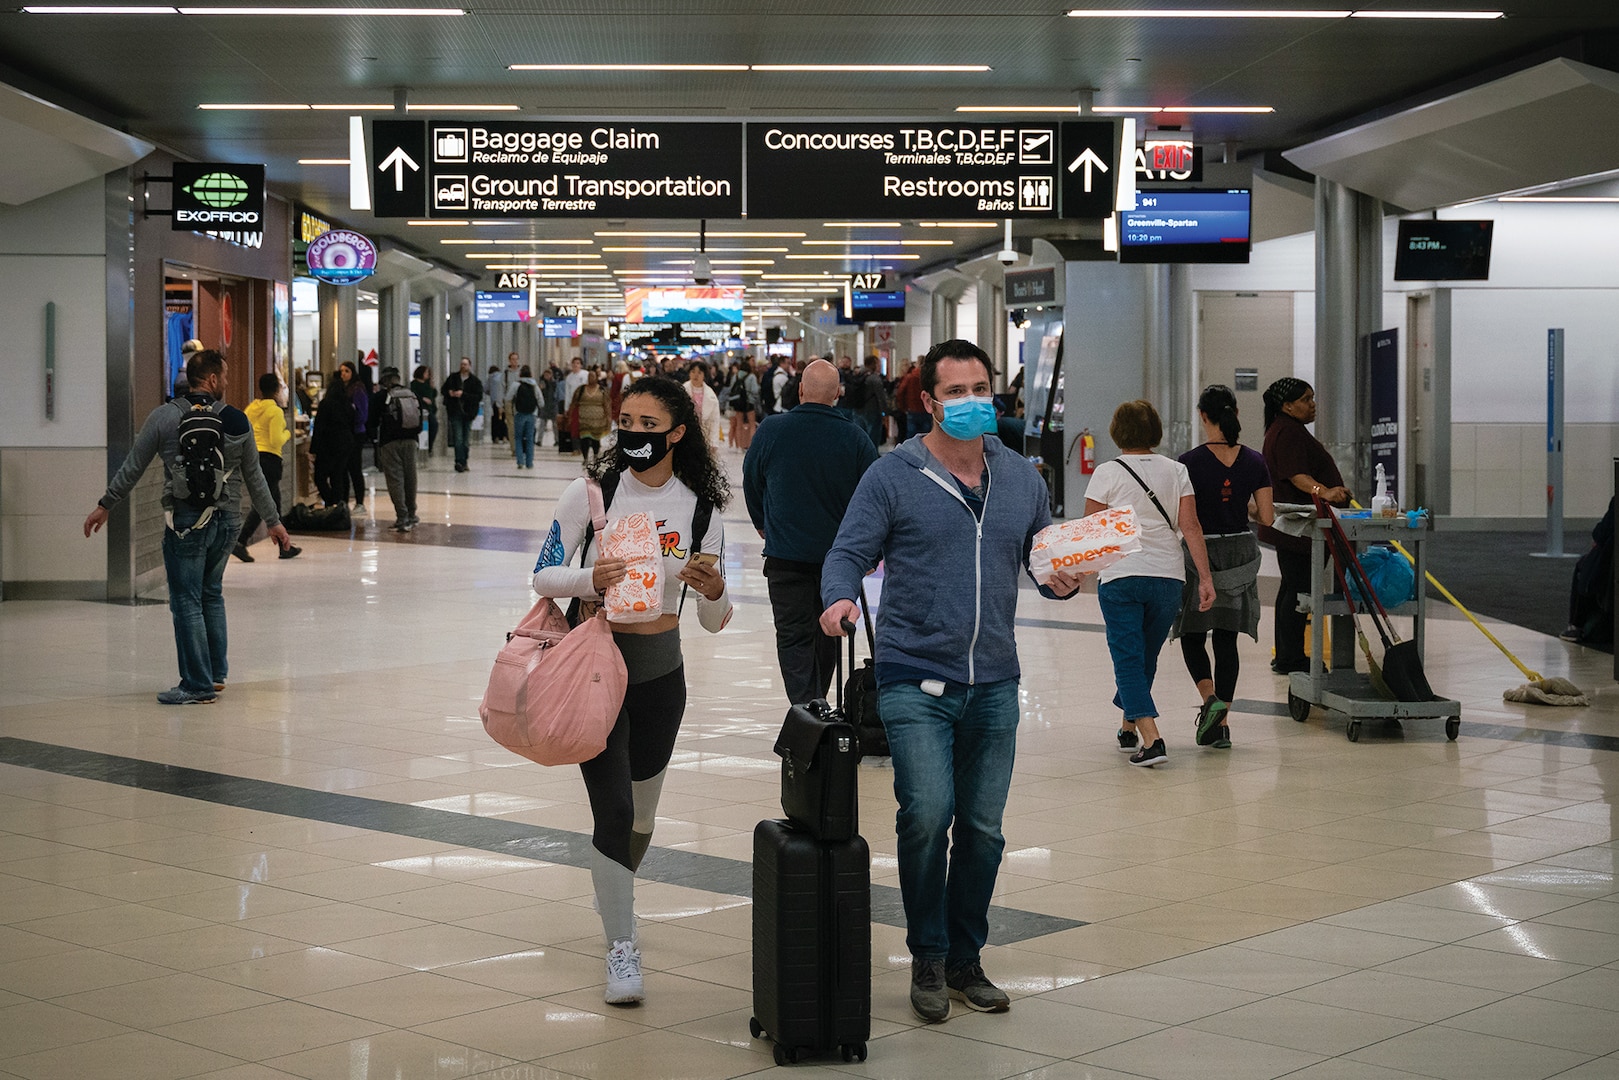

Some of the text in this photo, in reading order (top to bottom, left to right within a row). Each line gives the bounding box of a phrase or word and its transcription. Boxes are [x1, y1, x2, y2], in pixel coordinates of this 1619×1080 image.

[472, 128, 660, 152] Baggage Claim
[765, 129, 1015, 152] Concourses T,B,C,D,E,F
[472, 152, 609, 165] Reclamo de Equipaje
[884, 152, 1015, 166] Terminales T,B,C,D,E,F
[1153, 145, 1185, 169] EXIT
[472, 175, 731, 199] Ground Transportation
[884, 176, 1015, 197] Restrooms
[472, 199, 596, 213] Transporte Terrestre
[977, 199, 1015, 212] Baños
[176, 209, 259, 224] EXOFFICIO
[1127, 217, 1198, 229] Greenville-Spartan
[311, 232, 373, 256] GOLDBERG'S
[1127, 233, 1162, 243] 10:20 pm
[497, 272, 529, 289] A16
[852, 273, 883, 289] A17
[557, 305, 578, 317] A18
